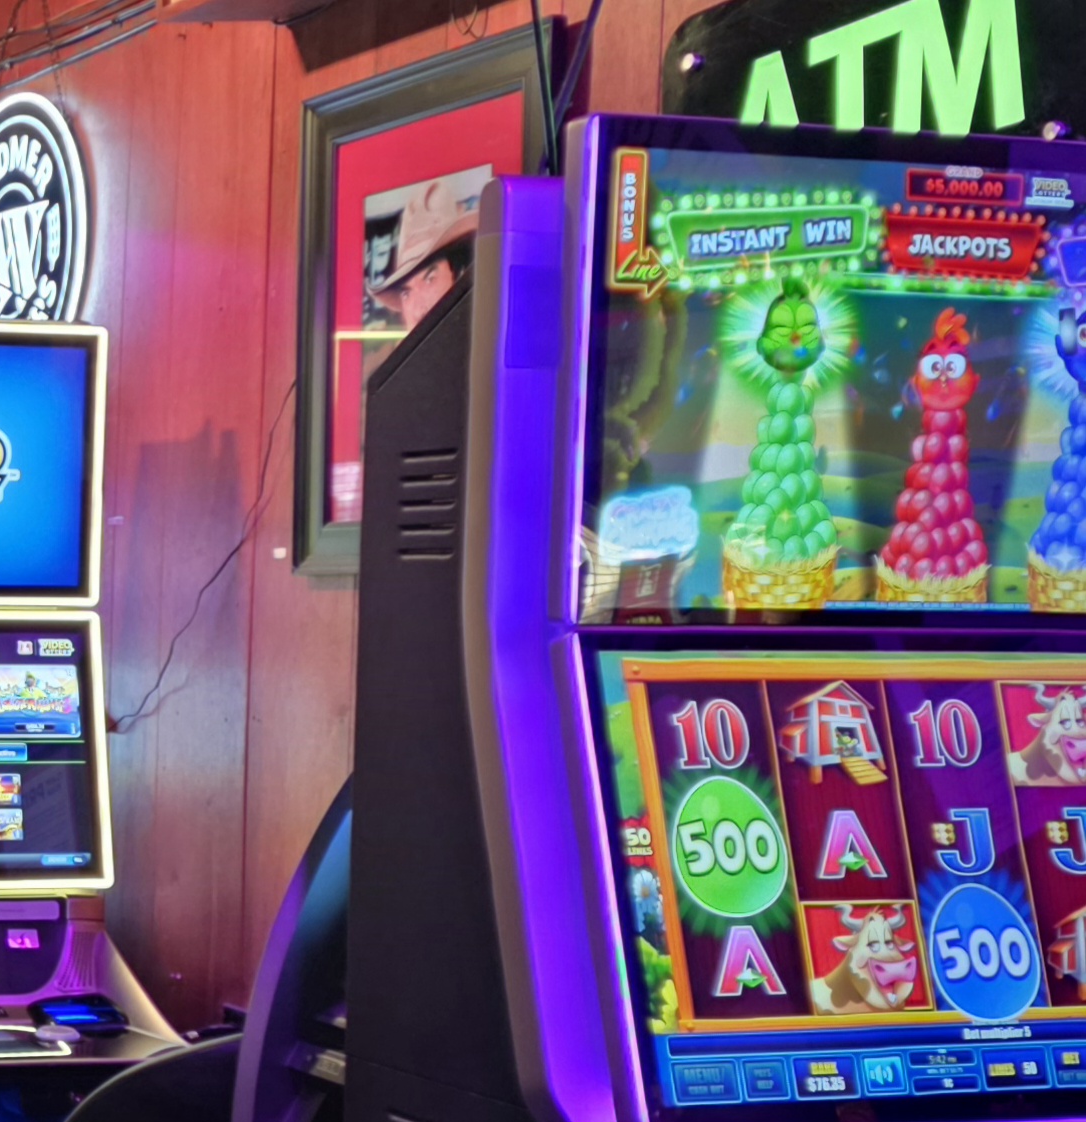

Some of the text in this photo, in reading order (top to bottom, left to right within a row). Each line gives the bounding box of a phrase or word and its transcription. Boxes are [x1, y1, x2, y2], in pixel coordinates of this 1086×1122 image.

[740, 0, 1025, 136] ATM
[926, 178, 1003, 197] $5,000.00
[945, 165, 984, 179] GRAND
[622, 172, 637, 240] BONUS
[617, 249, 662, 280] Line
[690, 218, 852, 256] INSTANT WIN
[908, 234, 1011, 260] JACKPOTS
[673, 699, 750, 770] 10
[911, 699, 982, 768] 10
[624, 827, 652, 846] 50
[676, 818, 779, 877] 500
[817, 809, 888, 880] A
[936, 807, 996, 876] J
[714, 925, 787, 998] A
[933, 927, 1031, 981] 500
[1022, 1061, 1038, 1076] 50
